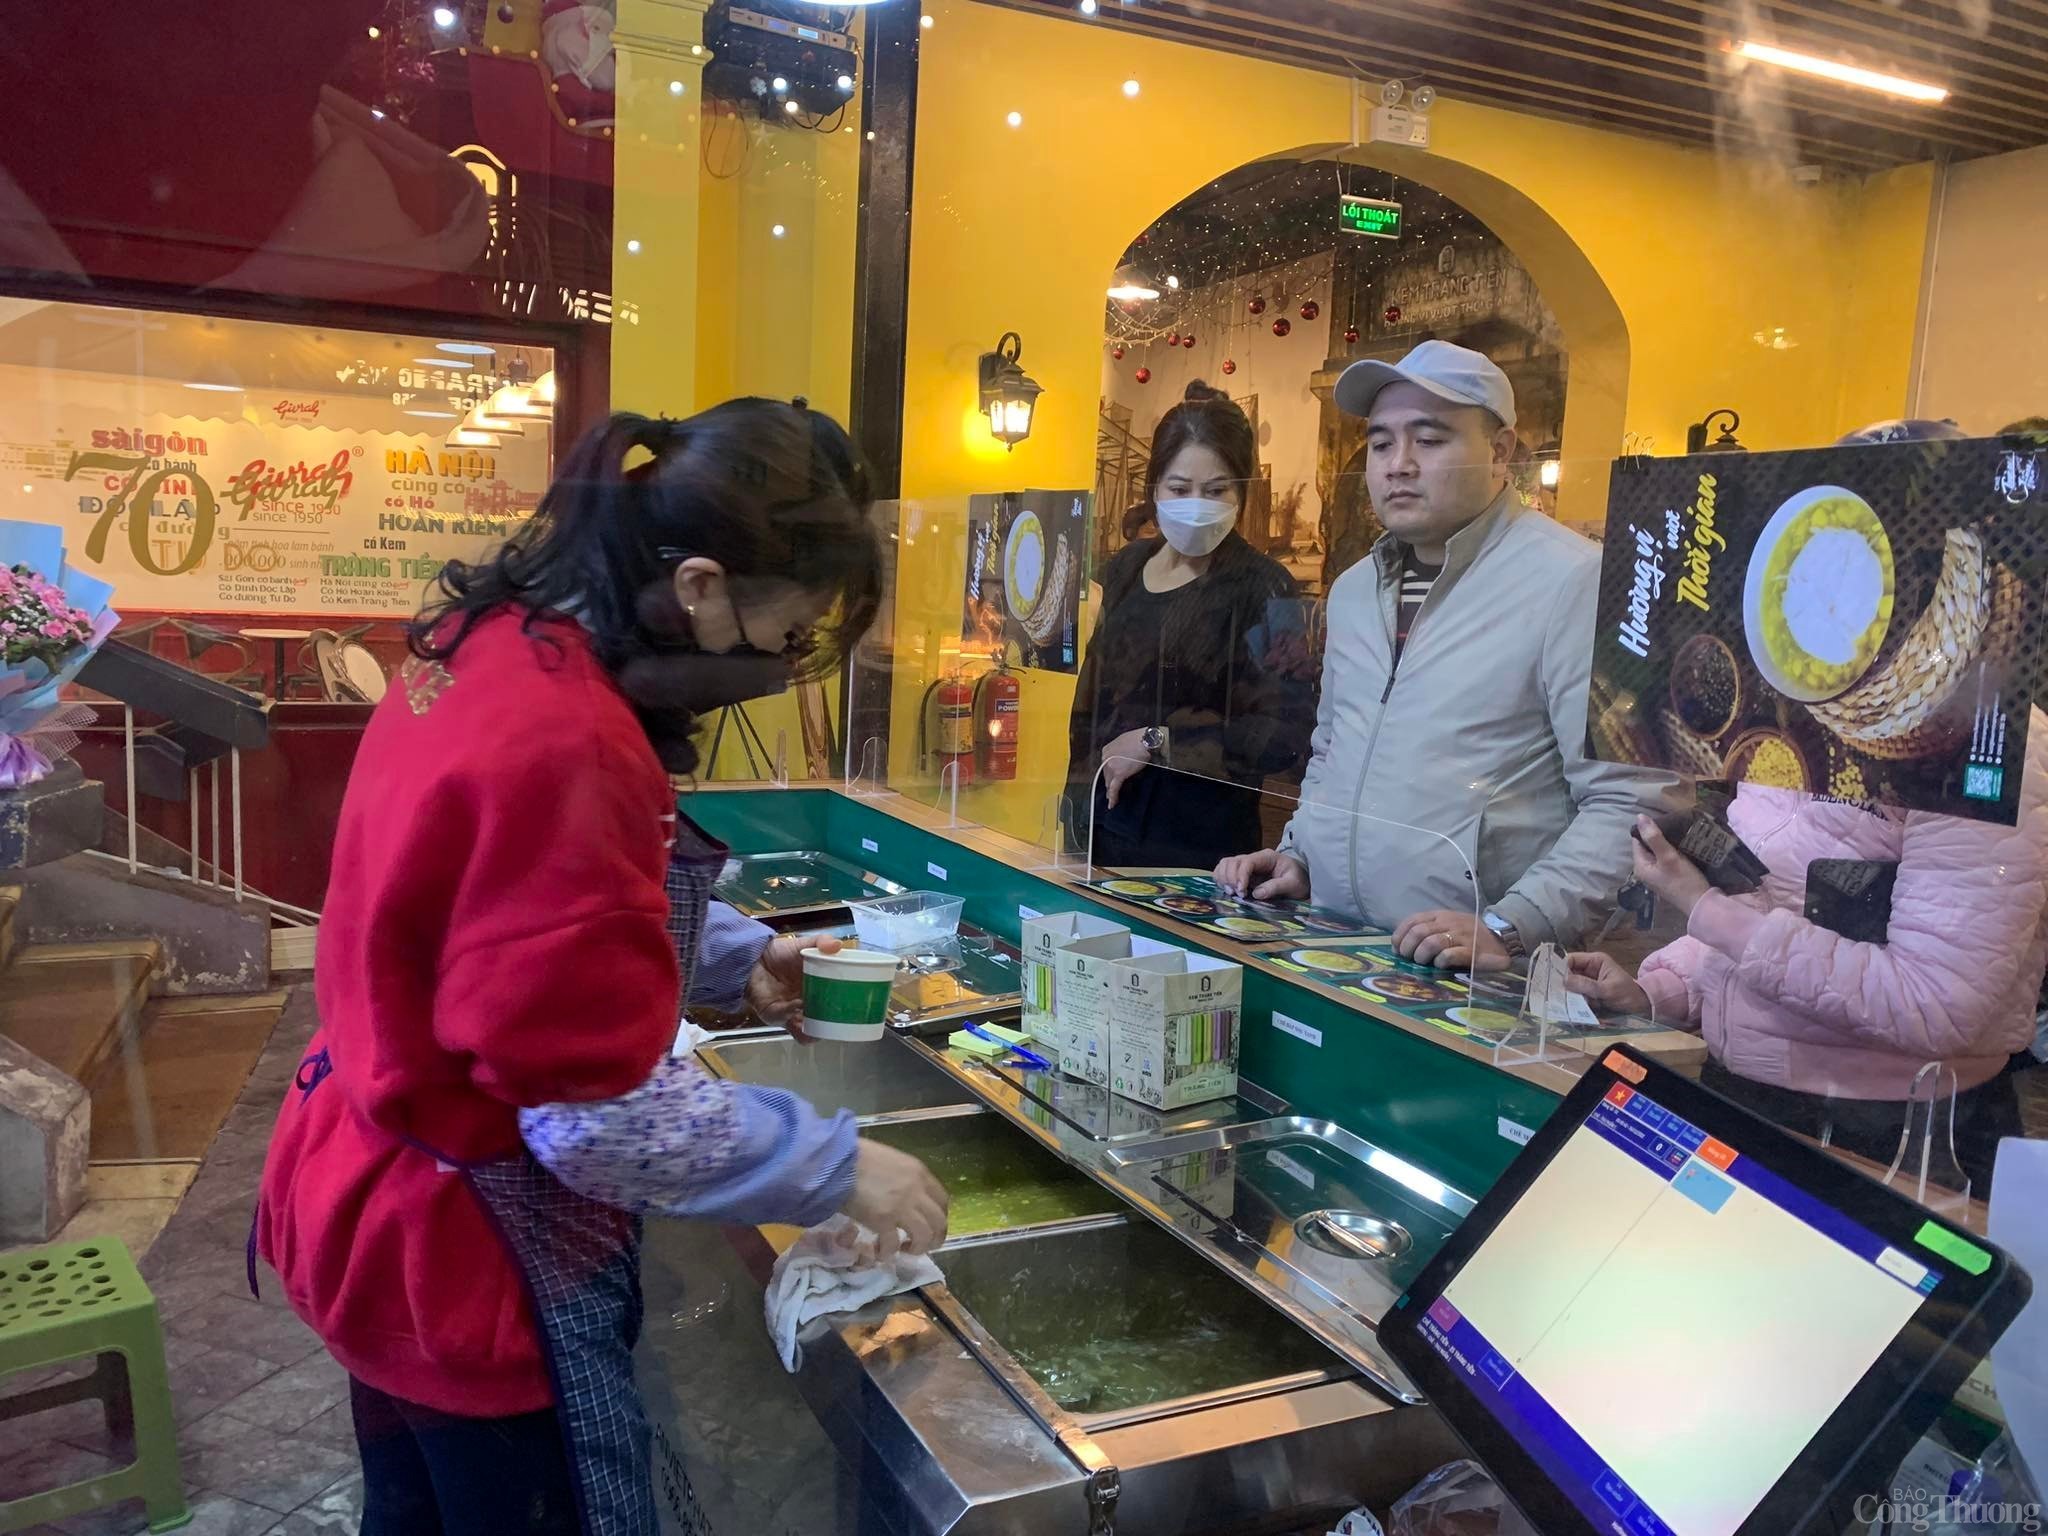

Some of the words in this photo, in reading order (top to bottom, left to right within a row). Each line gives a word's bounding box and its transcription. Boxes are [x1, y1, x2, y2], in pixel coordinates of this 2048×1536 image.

[1342, 202, 1361, 219] LỐI
[1361, 208, 1399, 225] THOÁT
[385, 445, 434, 477] HÀ
[438, 449, 496, 483] NỘI
[63, 450, 216, 577] 70
[1686, 472, 1727, 553] gian
[319, 551, 391, 578] TRÀNG
[379, 537, 407, 551] Kem
[1676, 539, 1712, 612] Thời
[1617, 553, 1667, 658] Hương
